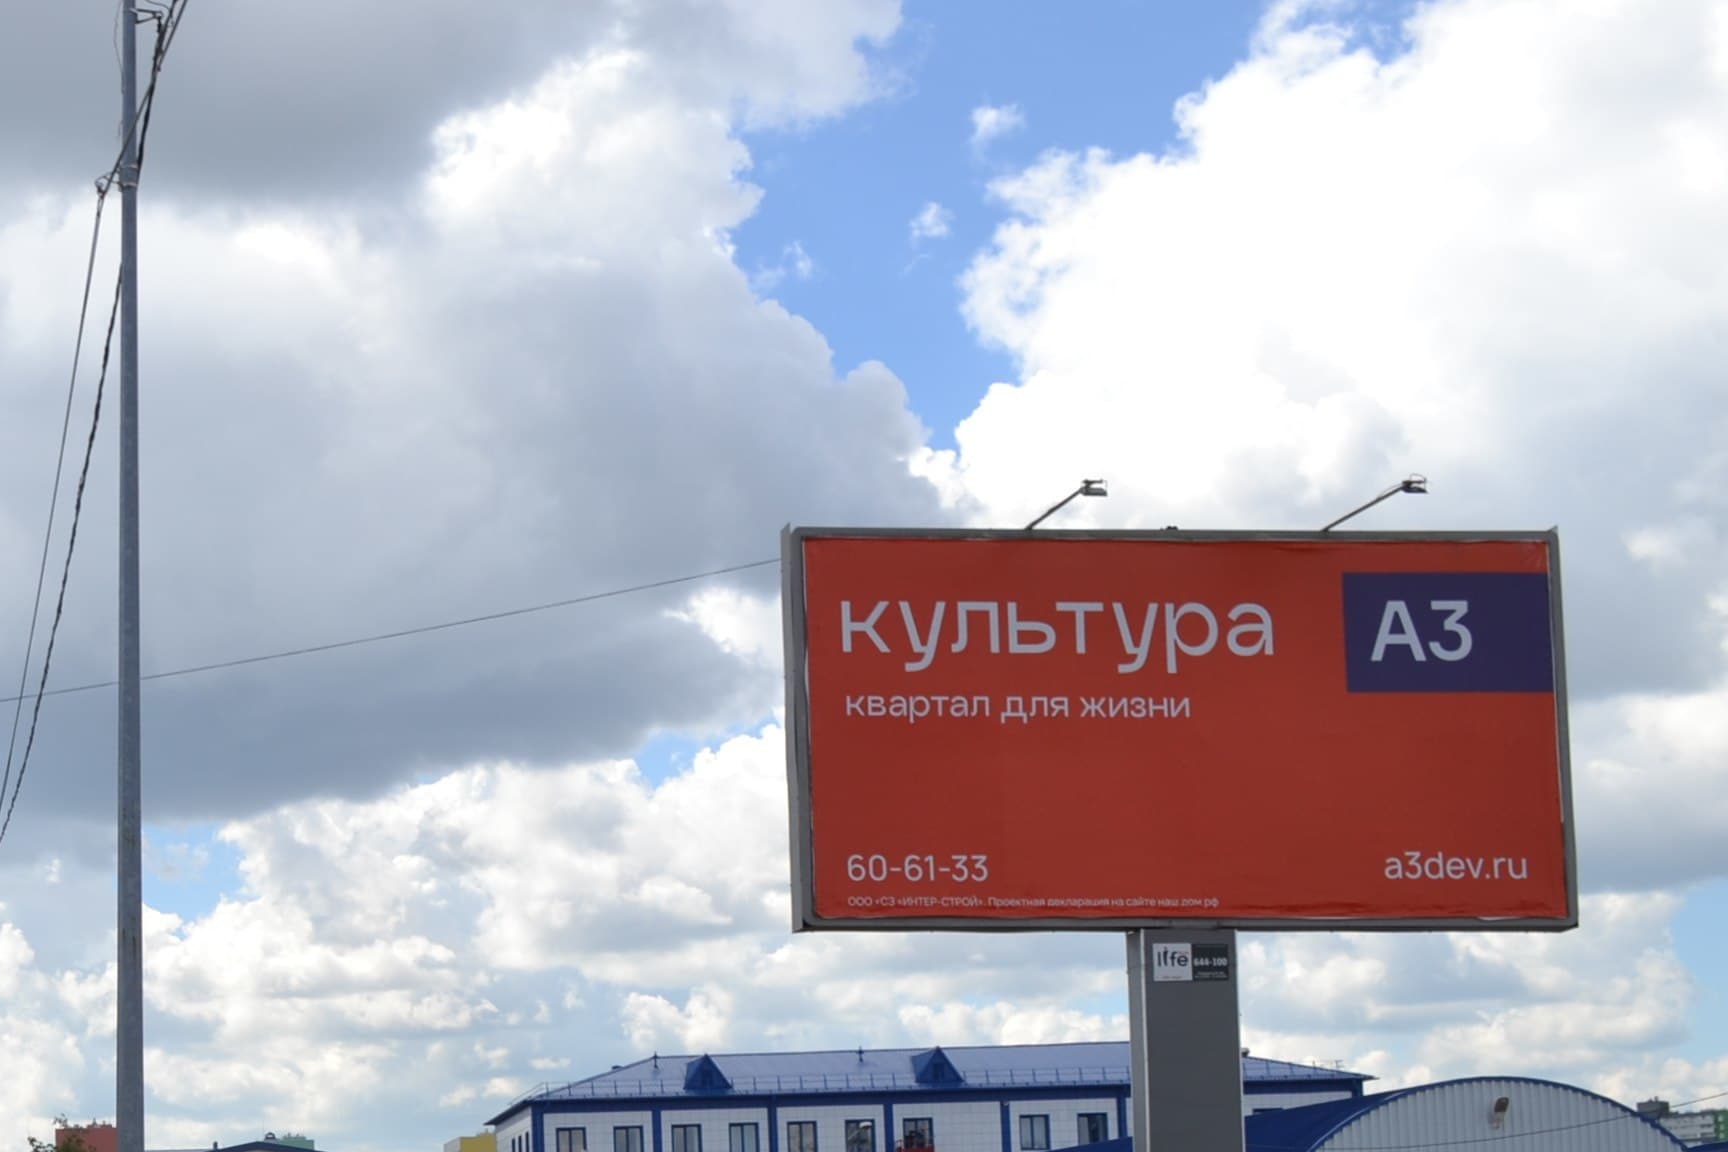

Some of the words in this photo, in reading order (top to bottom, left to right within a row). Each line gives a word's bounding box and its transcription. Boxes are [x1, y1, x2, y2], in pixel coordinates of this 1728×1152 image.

[840, 600, 1274, 674] культура
[845, 695, 990, 723] квартал
[1001, 696, 1069, 723] для
[1080, 697, 1191, 718] жизни
[847, 854, 989, 882] 60-61-33
[1384, 851, 1529, 880] a3dev.ru
[847, 896, 873, 907] ООО
[1157, 946, 1189, 967] life
[1193, 957, 1228, 967] 644-100
